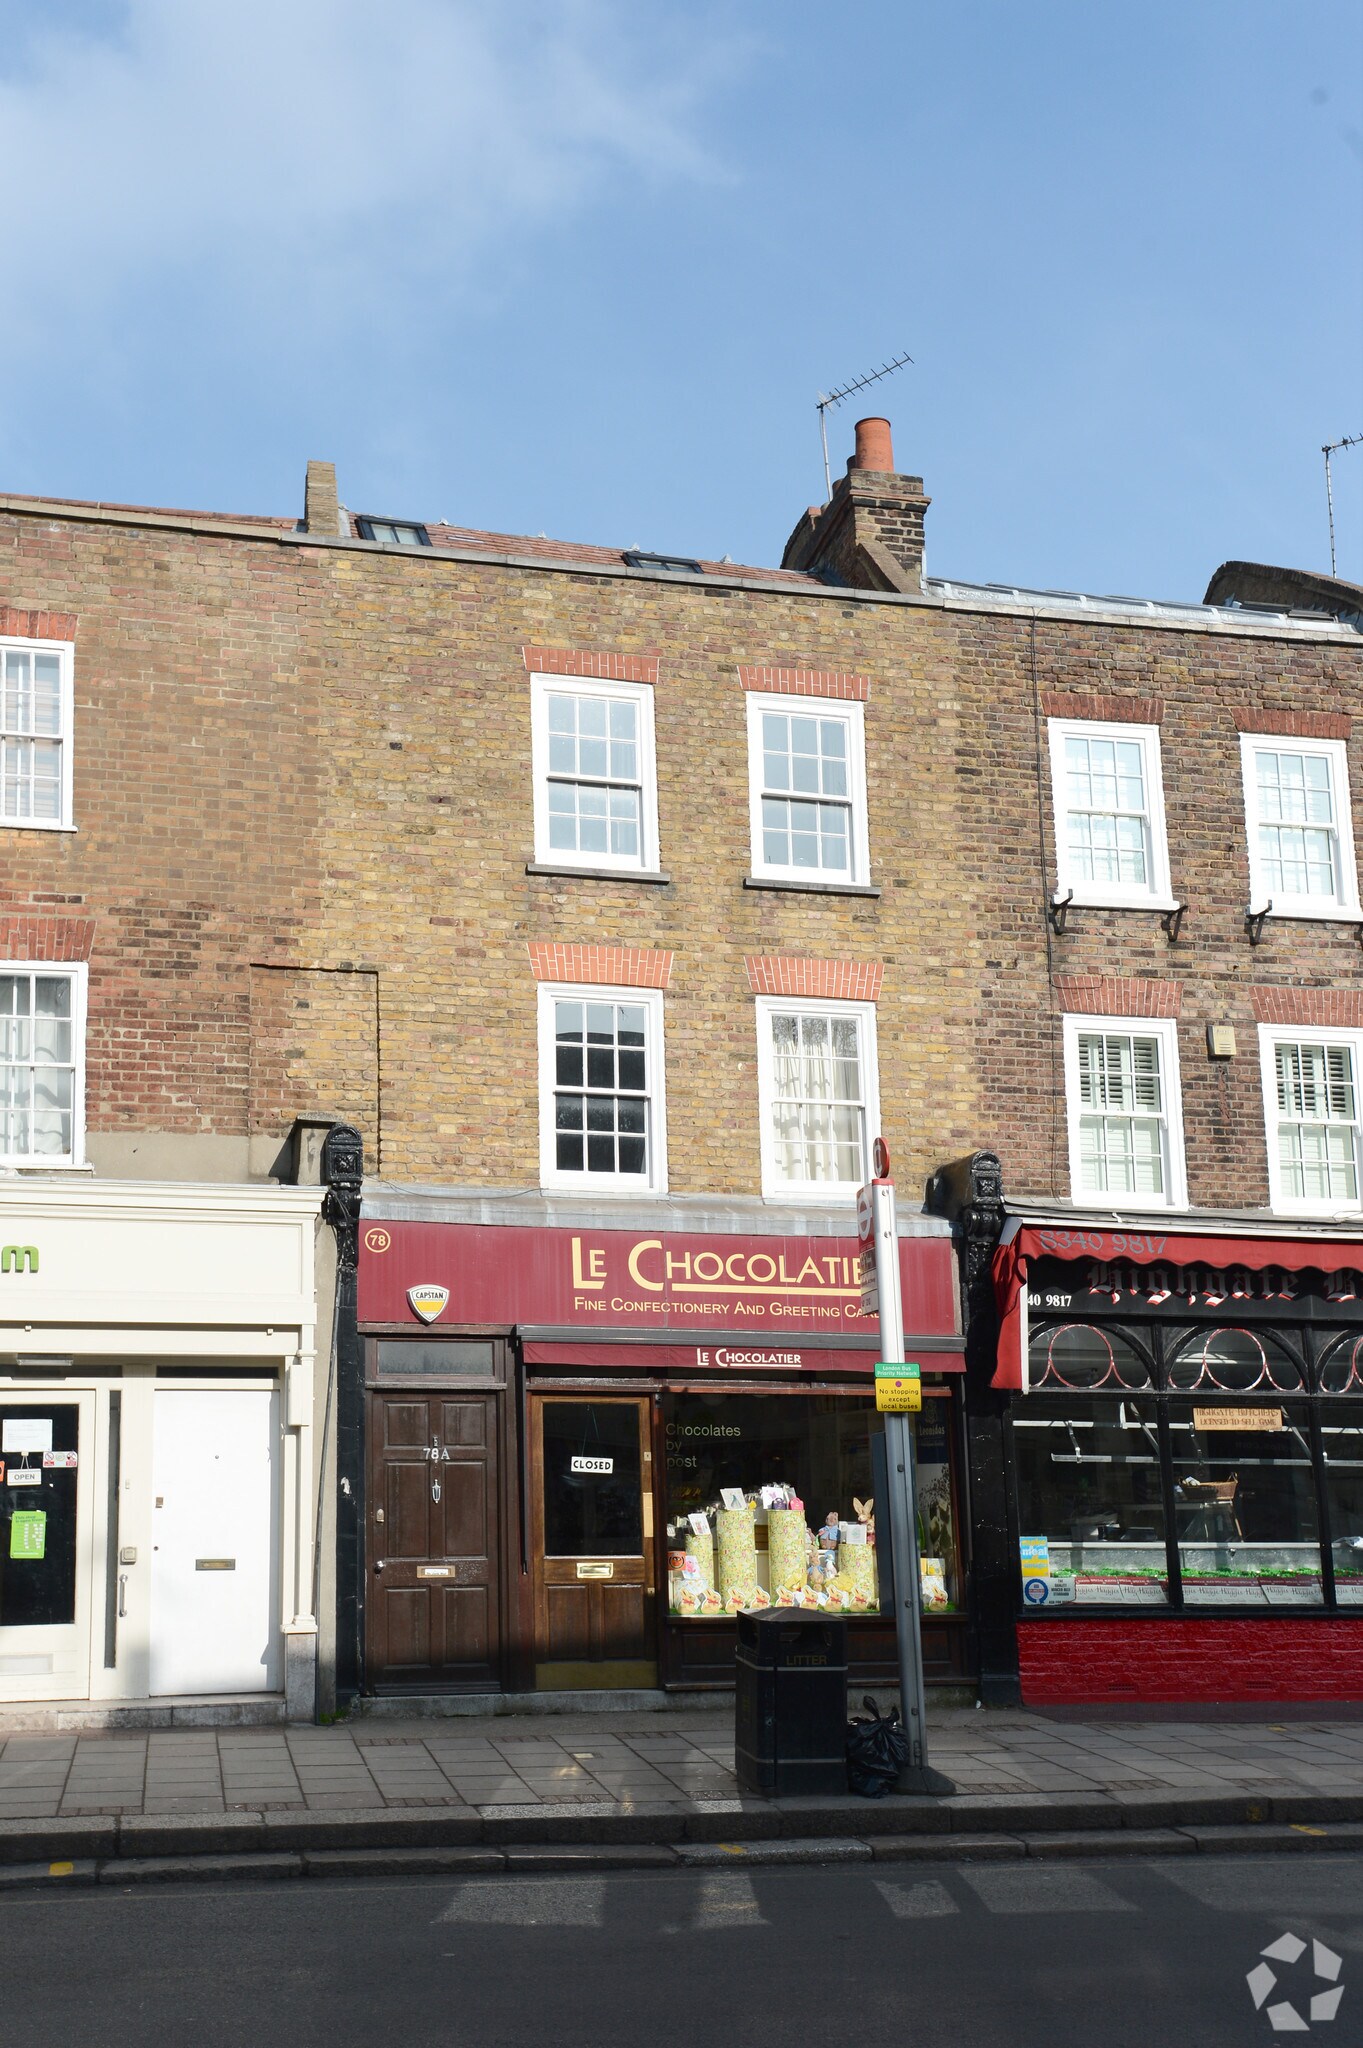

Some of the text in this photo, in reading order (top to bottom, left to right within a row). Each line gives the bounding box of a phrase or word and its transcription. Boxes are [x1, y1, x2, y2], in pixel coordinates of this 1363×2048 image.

[370, 1234, 386, 1247] 78
[1039, 1230, 1168, 1254] 8340 9817
[572, 1237, 861, 1291] LE CHOCOLATIE
[415, 1290, 444, 1300] CAPSTAN
[1045, 1294, 1072, 1307] 9817
[574, 1297, 607, 1311] FINE
[611, 1297, 730, 1315] CONFECTIONERY
[734, 1301, 765, 1316] AND
[769, 1301, 841, 1318] GREETING
[696, 1348, 802, 1367] LE CHOCOLATIER
[665, 1423, 741, 1437] Chocolates
[665, 1439, 682, 1453] by
[422, 1447, 450, 1460] 78A
[572, 1459, 612, 1470] CLOSED
[666, 1455, 697, 1470] post
[13, 1473, 36, 1481] OPEN
[786, 1655, 828, 1666] LITTER
